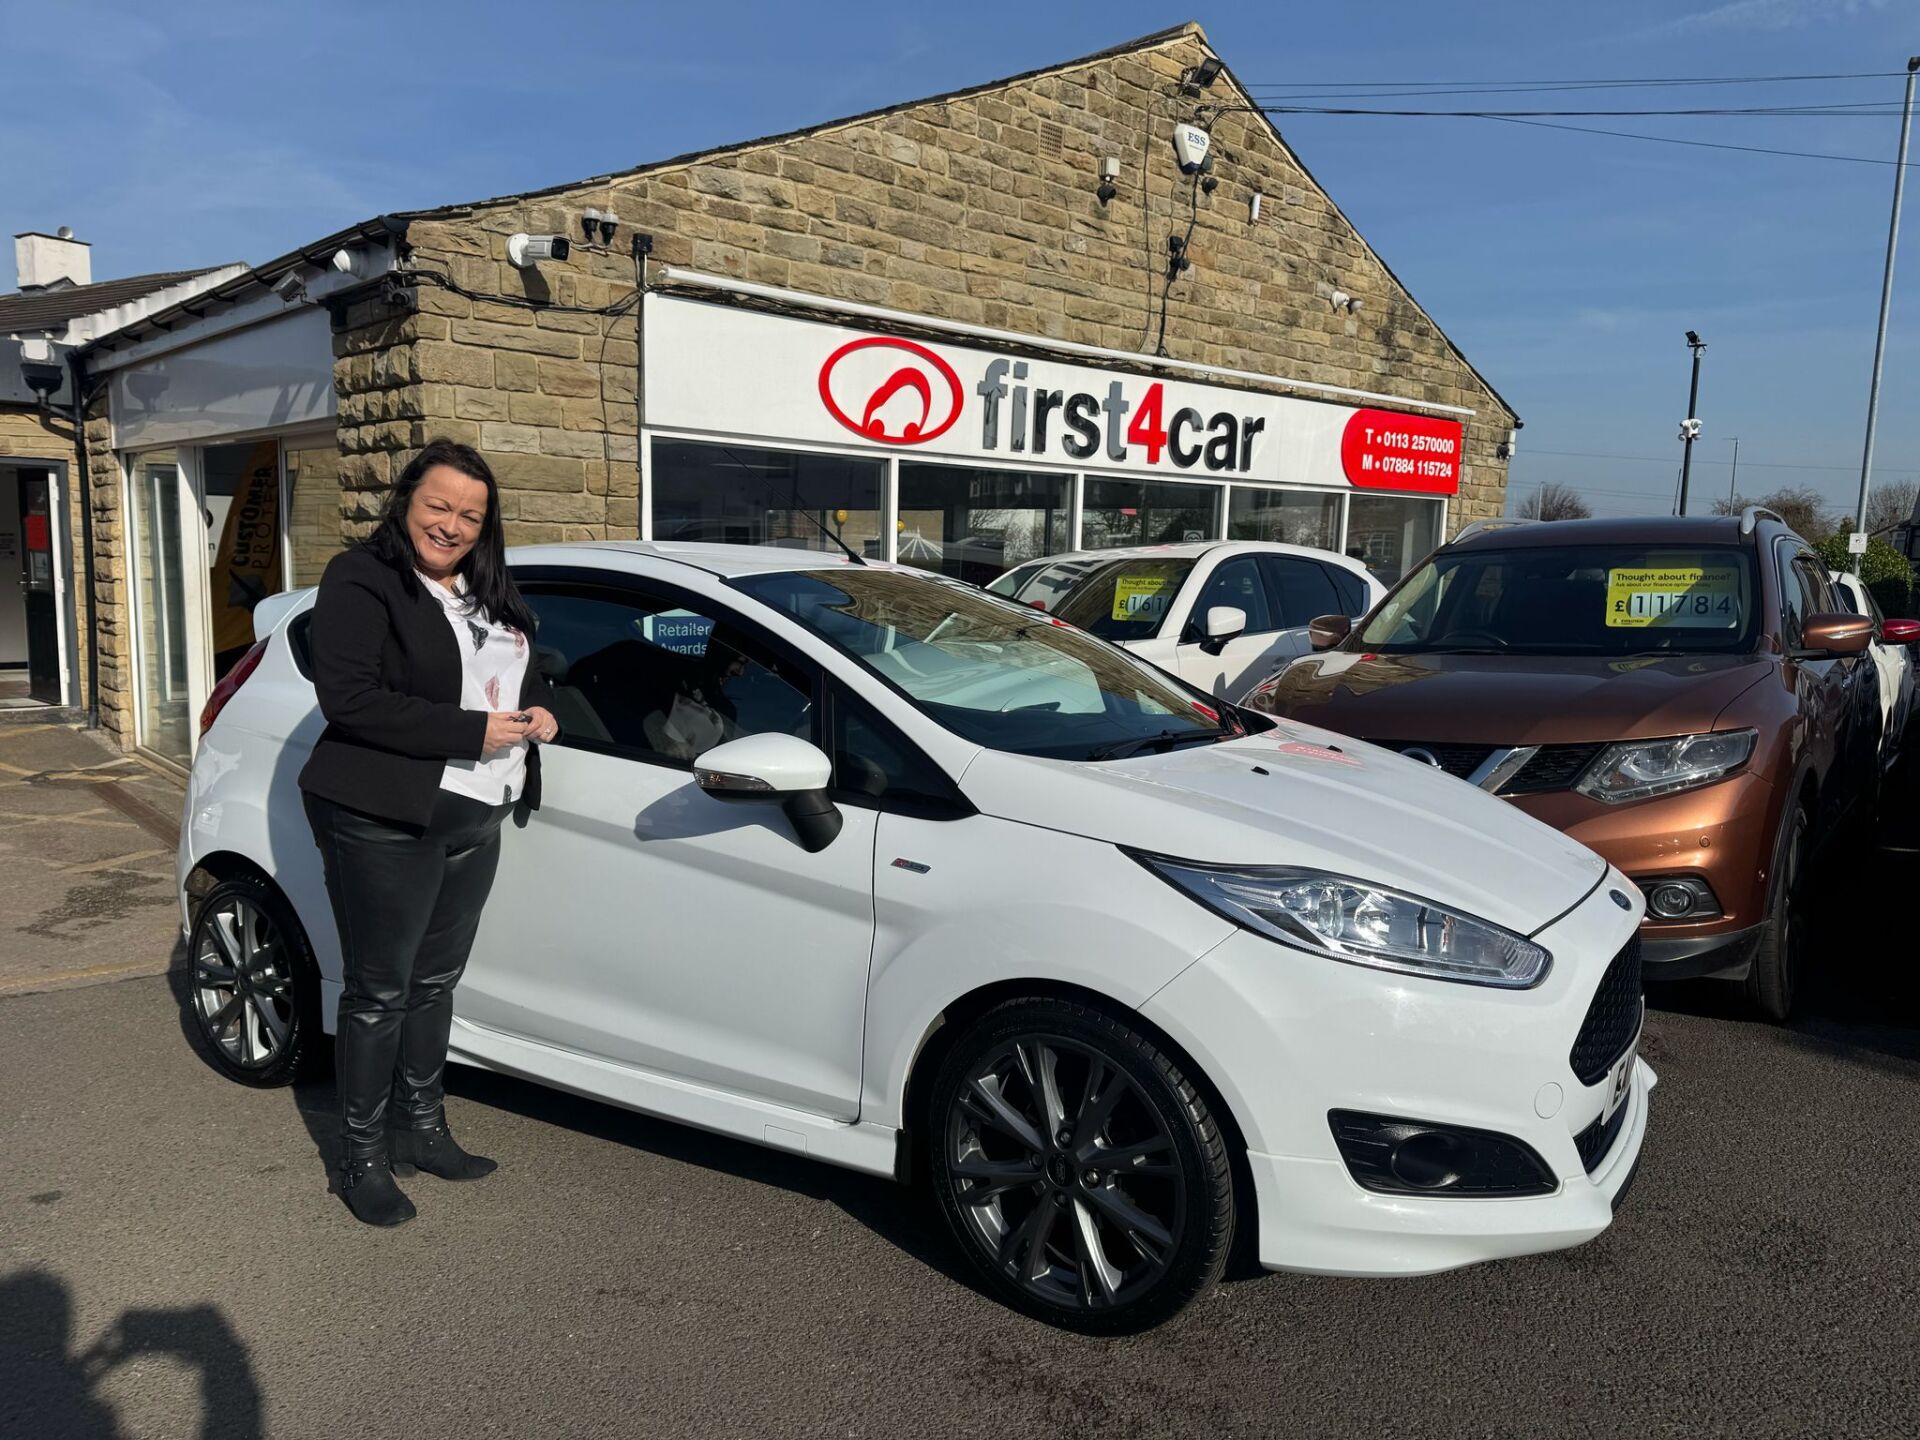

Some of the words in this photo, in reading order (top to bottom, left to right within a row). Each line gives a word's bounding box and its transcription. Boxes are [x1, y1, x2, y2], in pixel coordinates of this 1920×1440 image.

[1187, 131, 1206, 147] ESS
[977, 358, 1265, 473] first4car
[1365, 428, 1374, 445] T
[1383, 431, 1409, 449] 0113
[1411, 435, 1454, 454] 2570000
[1361, 453, 1373, 470] M
[1382, 456, 1414, 474] 07884
[1417, 460, 1452, 478] 115724
[231, 467, 273, 567] CUSTOMER
[1616, 573, 1655, 582] Thought
[1658, 573, 1686, 581] about
[1689, 573, 1732, 581] finance?
[658, 622, 711, 637] Retailer
